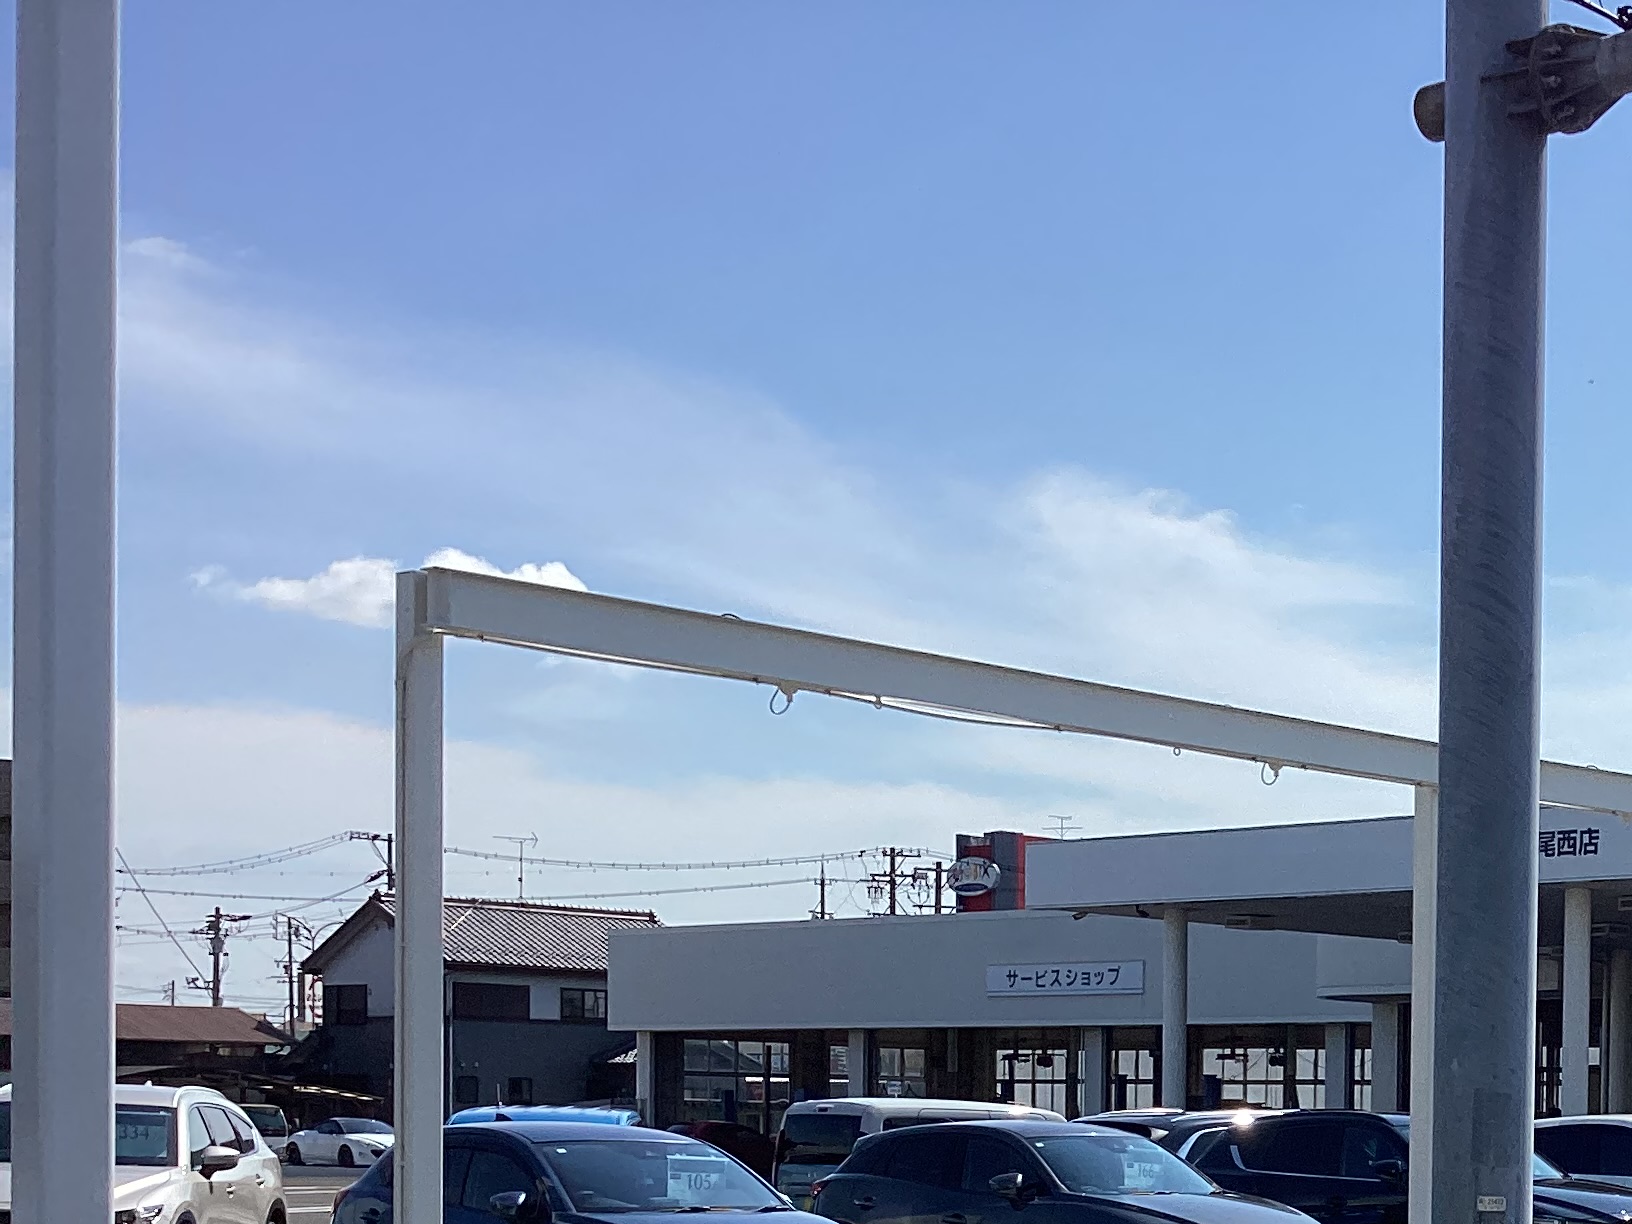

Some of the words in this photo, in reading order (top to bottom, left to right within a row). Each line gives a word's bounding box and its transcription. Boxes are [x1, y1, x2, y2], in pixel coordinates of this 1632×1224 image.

[1006, 966, 1121, 988] サービスショップ
